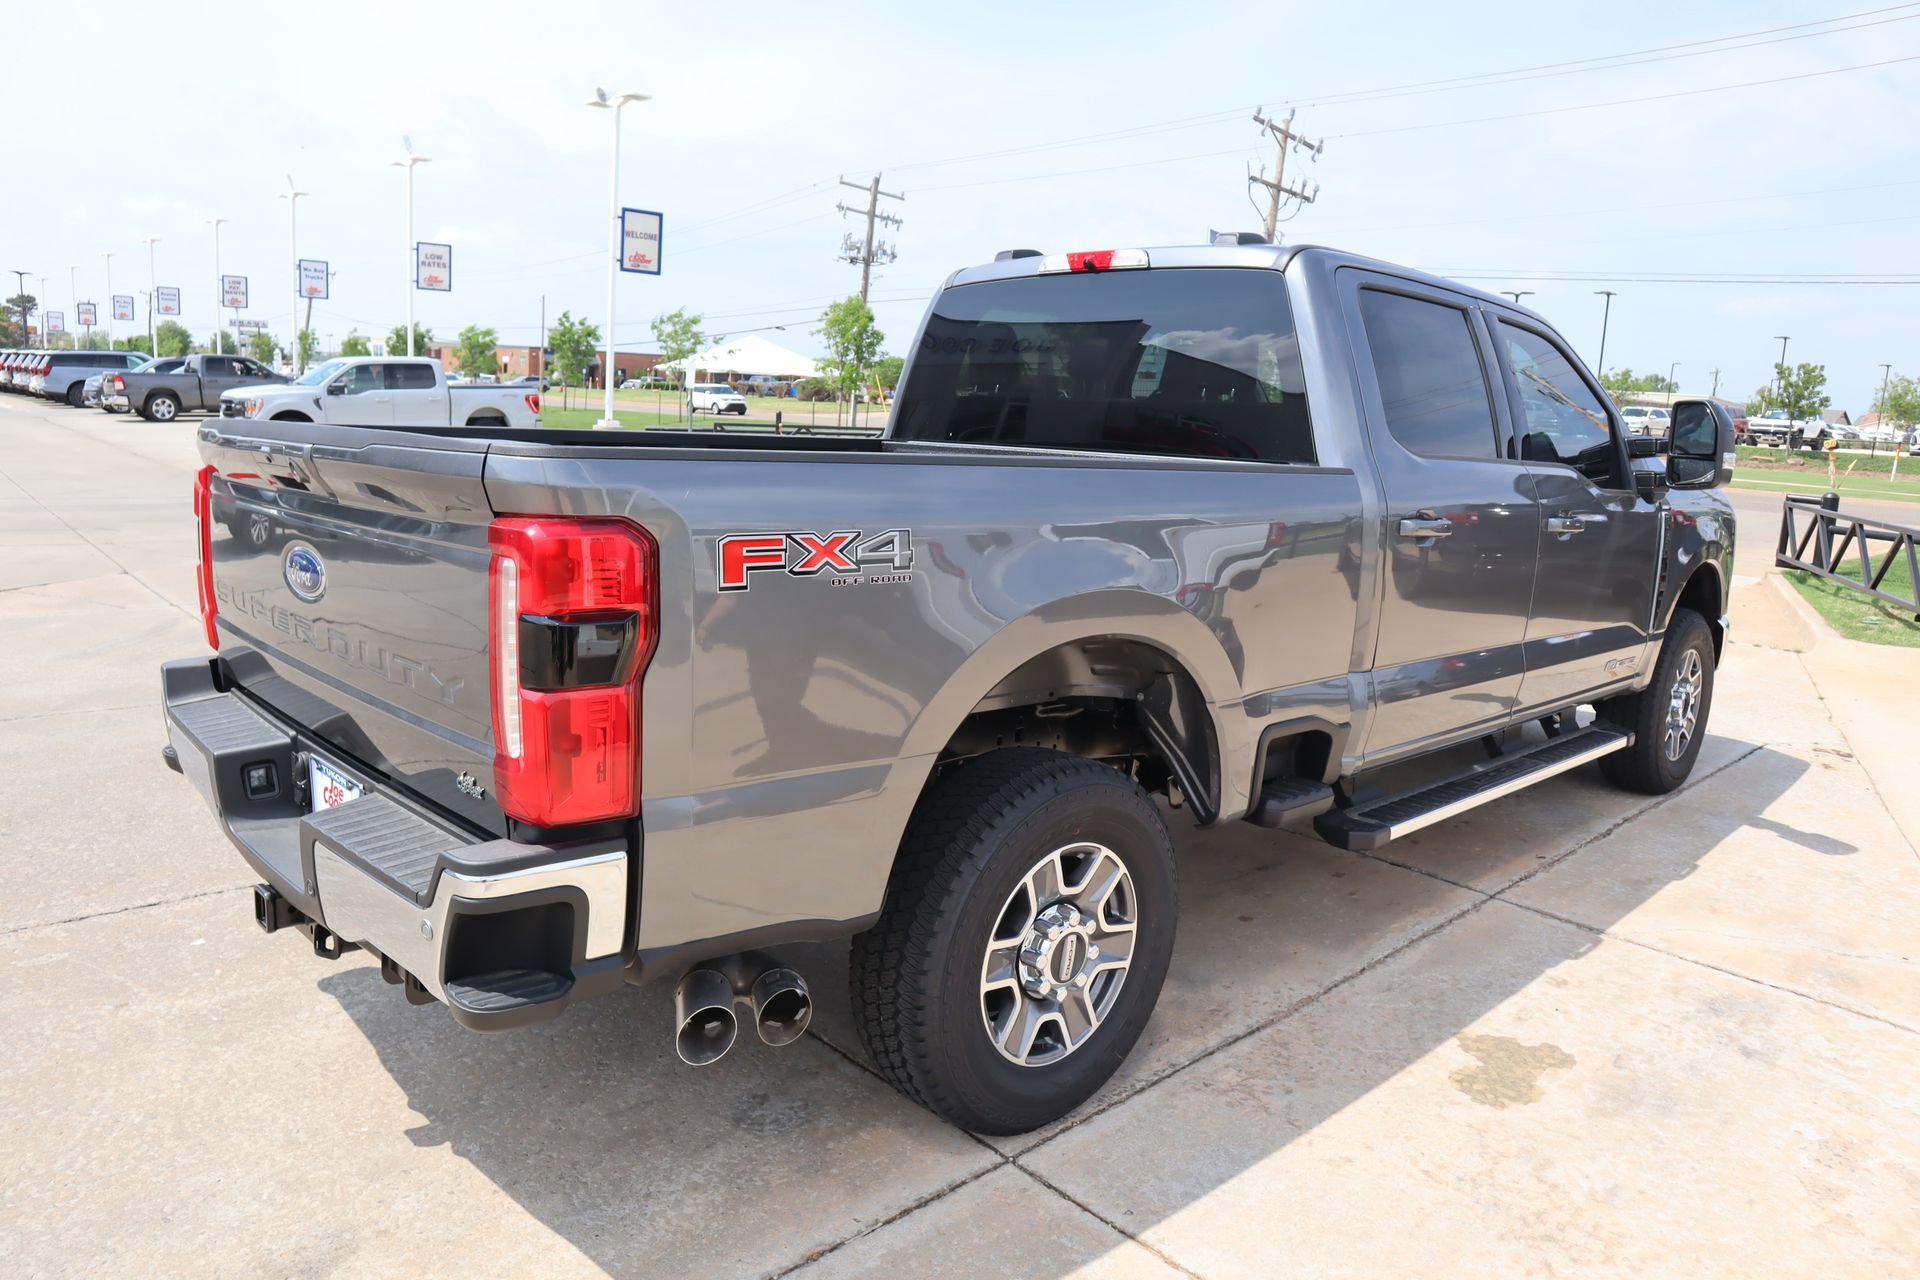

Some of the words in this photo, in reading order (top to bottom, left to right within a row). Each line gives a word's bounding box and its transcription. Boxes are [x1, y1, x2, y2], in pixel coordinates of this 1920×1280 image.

[624, 230, 658, 242] WELCOME
[421, 260, 447, 269] RATES
[424, 253, 443, 261] LOW
[717, 528, 915, 593] FX4
[831, 577, 864, 587] OFF
[870, 574, 913, 584] ROAD
[217, 581, 318, 650] SUPER
[327, 626, 465, 704] DUTY
[323, 786, 342, 808] Coo
[329, 777, 344, 801] Joe
[1065, 939, 1075, 977] FORD
